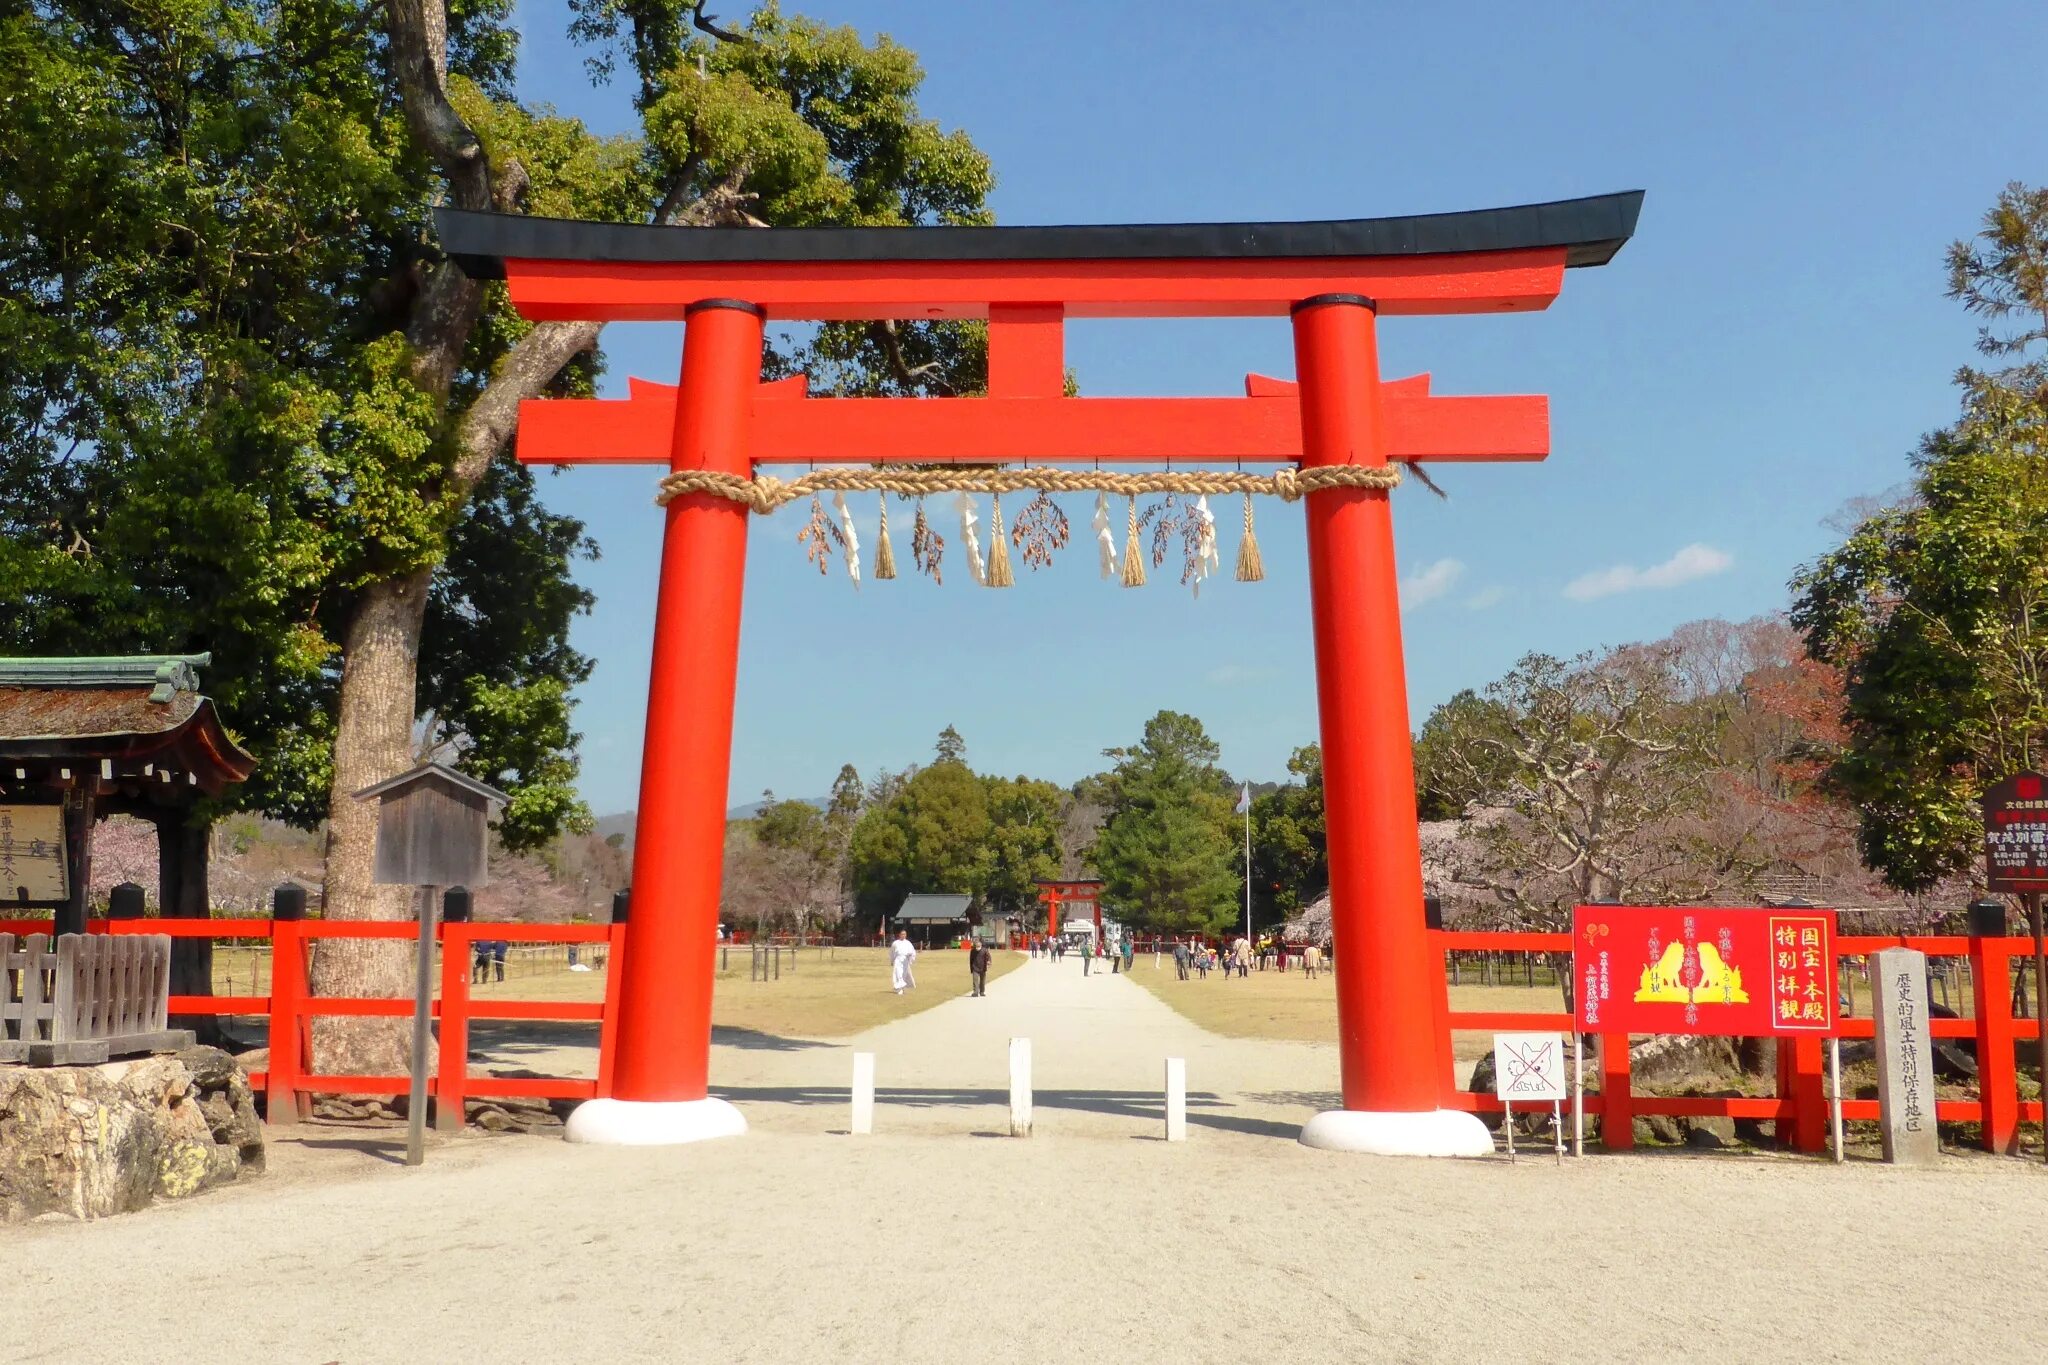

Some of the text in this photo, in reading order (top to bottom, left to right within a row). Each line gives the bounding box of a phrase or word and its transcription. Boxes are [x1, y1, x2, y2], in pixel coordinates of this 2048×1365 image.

[1775, 925, 1803, 1020] 特別拝観
[1801, 927, 1825, 1022] 国宝・本殿
[1895, 973, 1923, 1133] 歴史的風土特別保存地区
